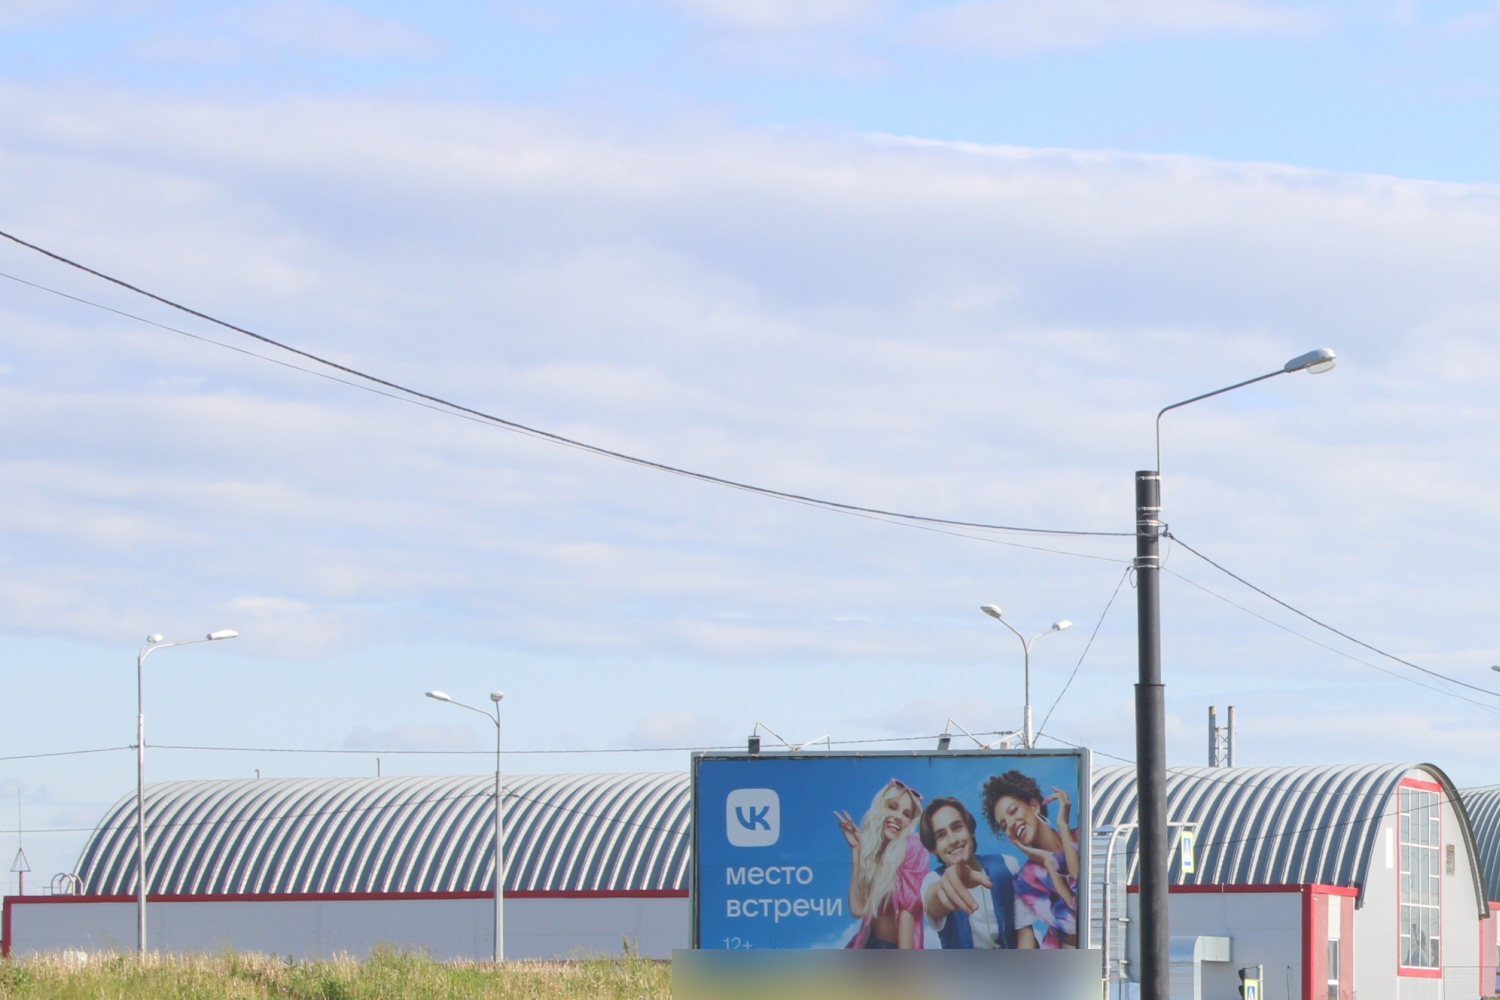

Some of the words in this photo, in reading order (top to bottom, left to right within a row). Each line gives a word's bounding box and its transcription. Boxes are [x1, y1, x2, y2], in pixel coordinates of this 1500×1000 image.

[726, 866, 814, 885] место
[726, 898, 843, 924] встречи
[723, 936, 753, 950] 12+
